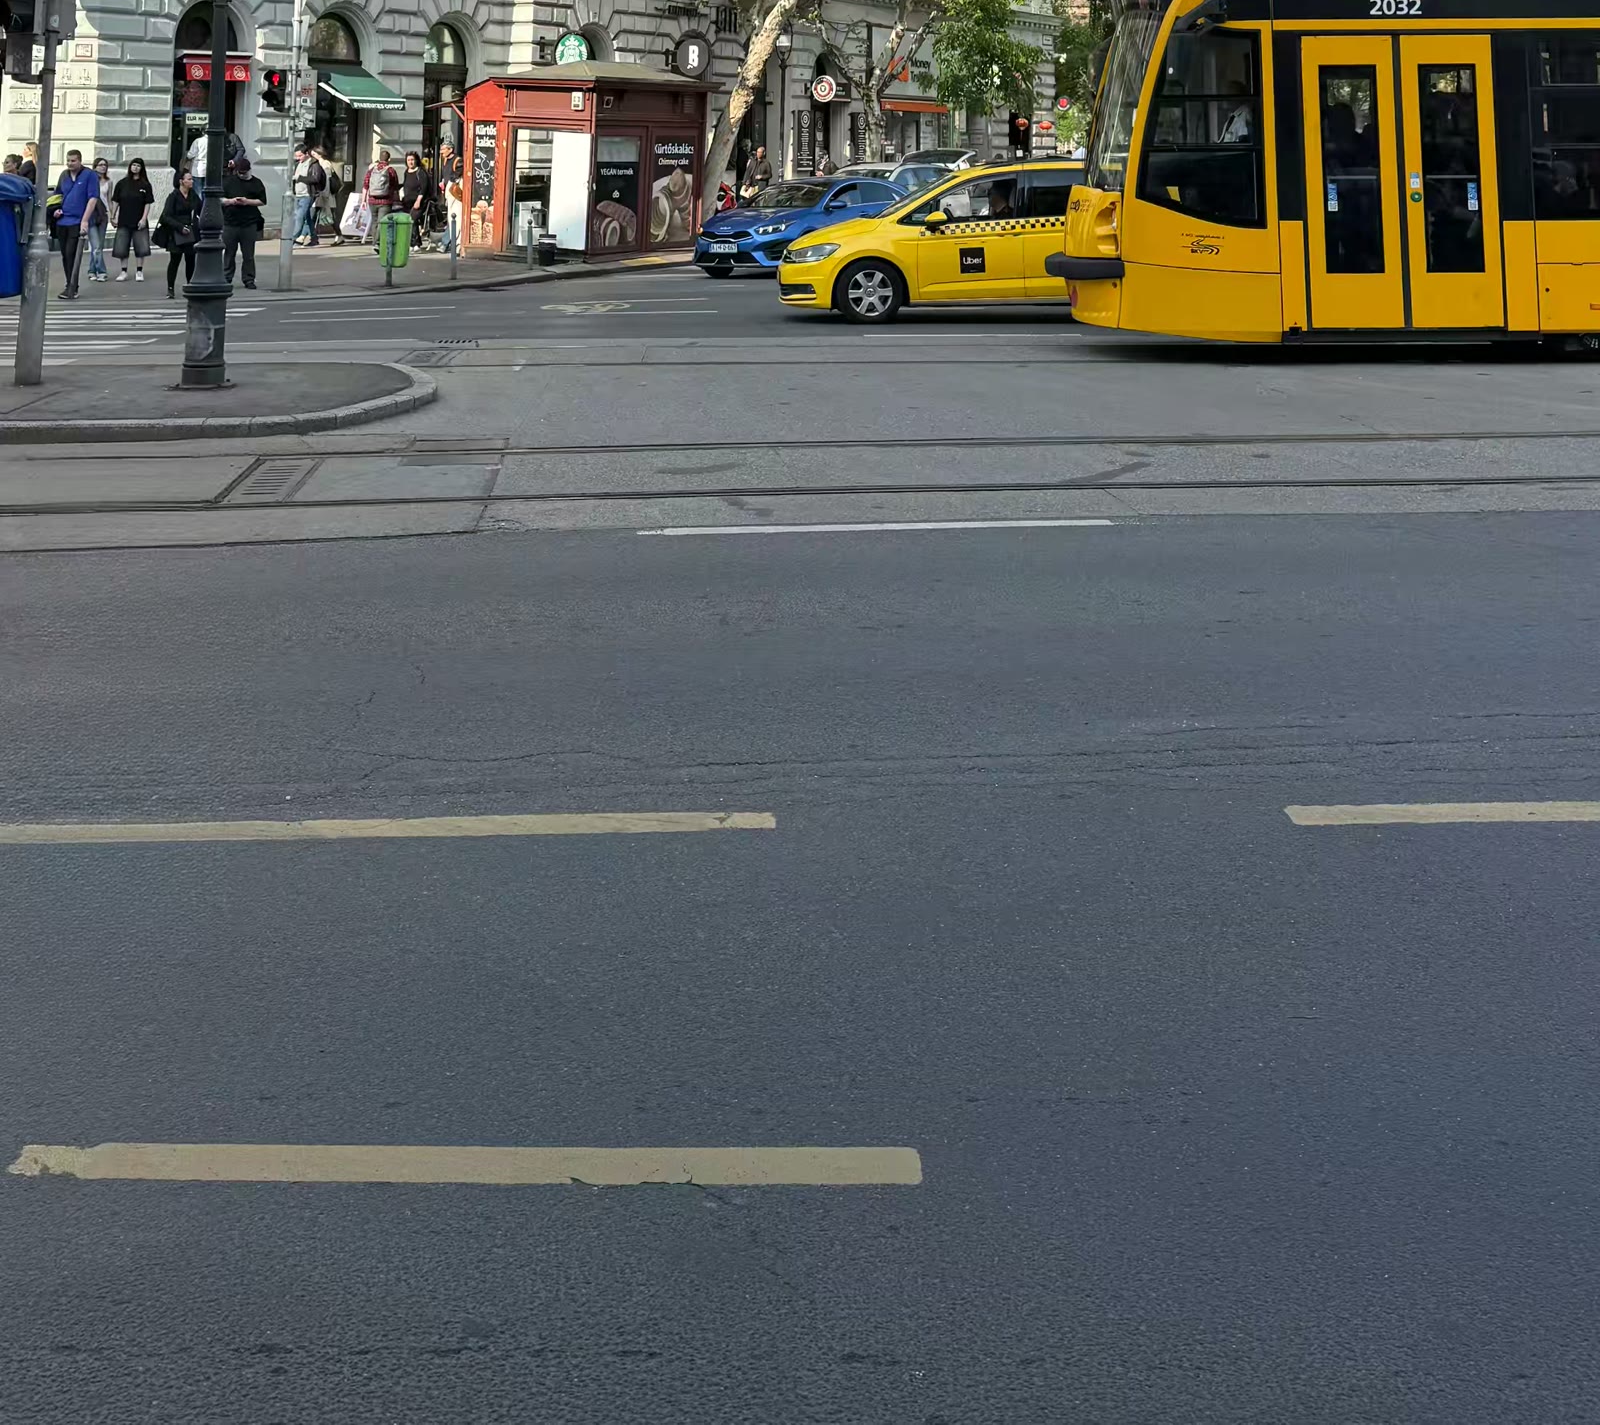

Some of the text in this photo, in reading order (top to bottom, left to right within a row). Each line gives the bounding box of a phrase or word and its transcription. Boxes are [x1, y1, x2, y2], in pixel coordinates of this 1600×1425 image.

[658, 157, 690, 167] Chimney cake
[963, 256, 983, 265] Uber
